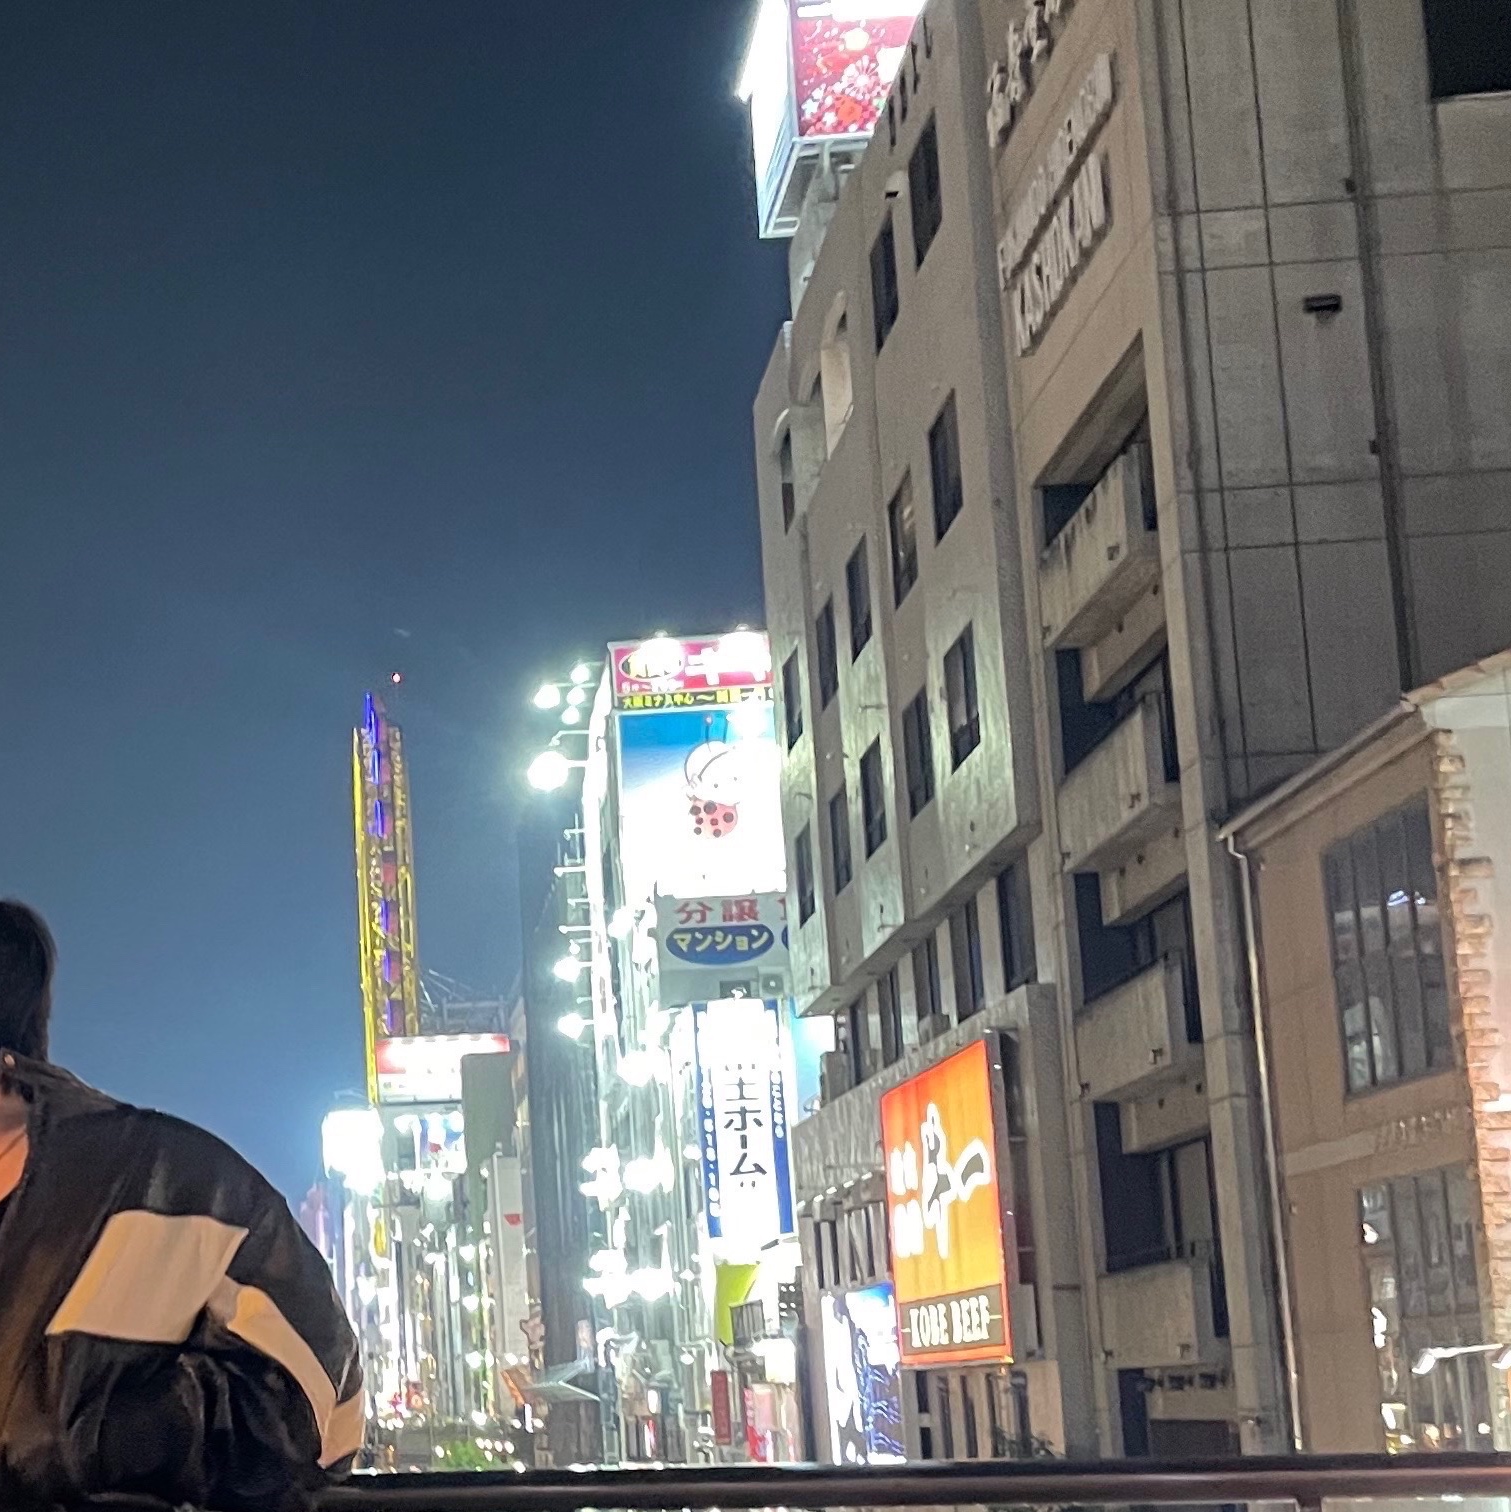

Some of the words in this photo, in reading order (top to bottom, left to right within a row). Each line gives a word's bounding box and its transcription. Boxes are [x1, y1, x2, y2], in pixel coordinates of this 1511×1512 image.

[672, 928, 770, 953] マンション
[908, 1303, 950, 1348] KOBE
[950, 1295, 990, 1345] BEEF
